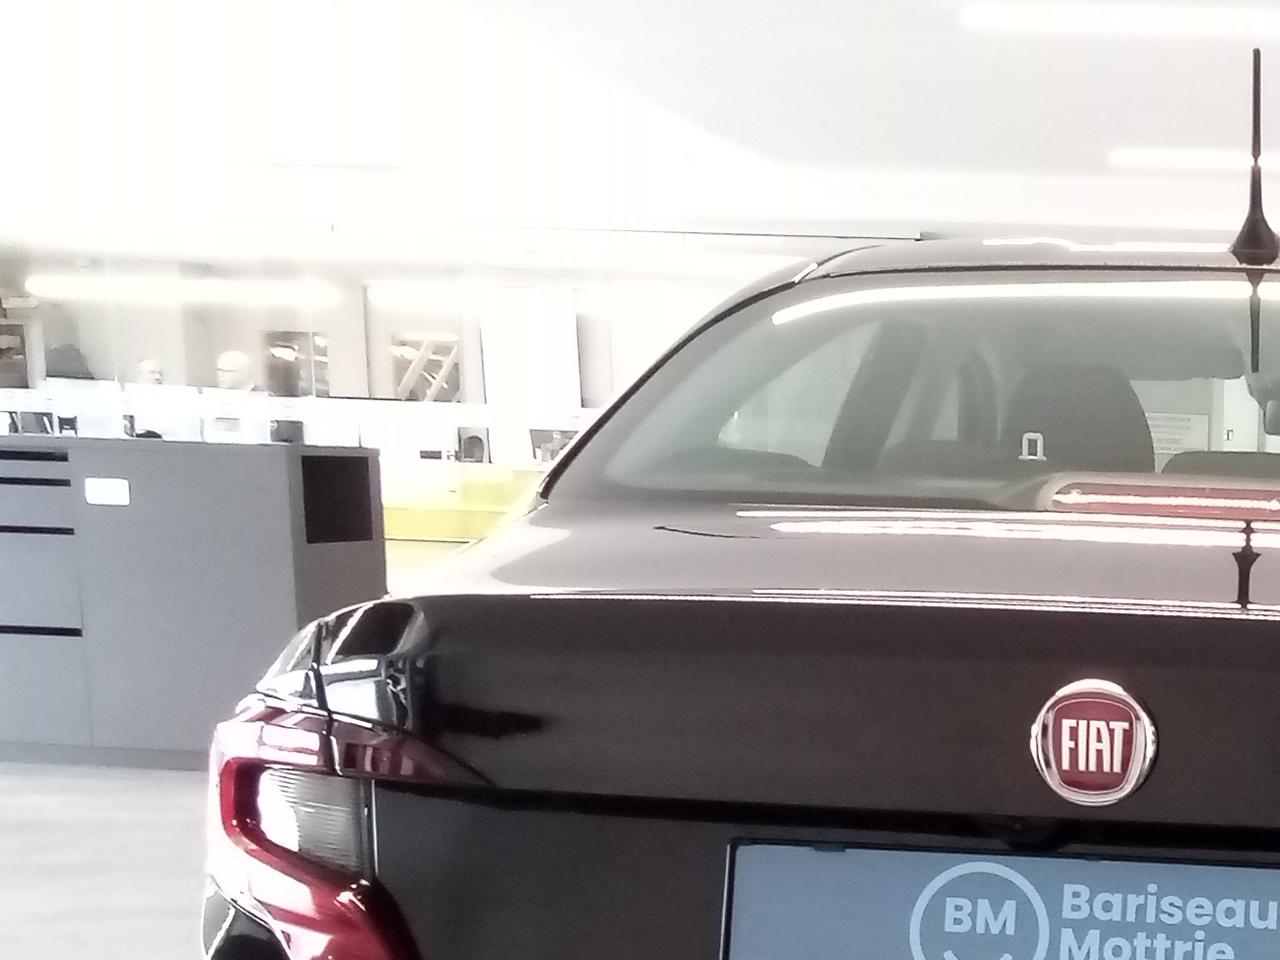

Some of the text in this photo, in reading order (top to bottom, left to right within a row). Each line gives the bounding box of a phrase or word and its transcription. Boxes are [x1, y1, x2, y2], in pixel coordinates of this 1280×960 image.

[1061, 719, 1129, 773] FIAT
[944, 897, 1016, 935] BM
[1062, 883, 1278, 930] Bariseau
